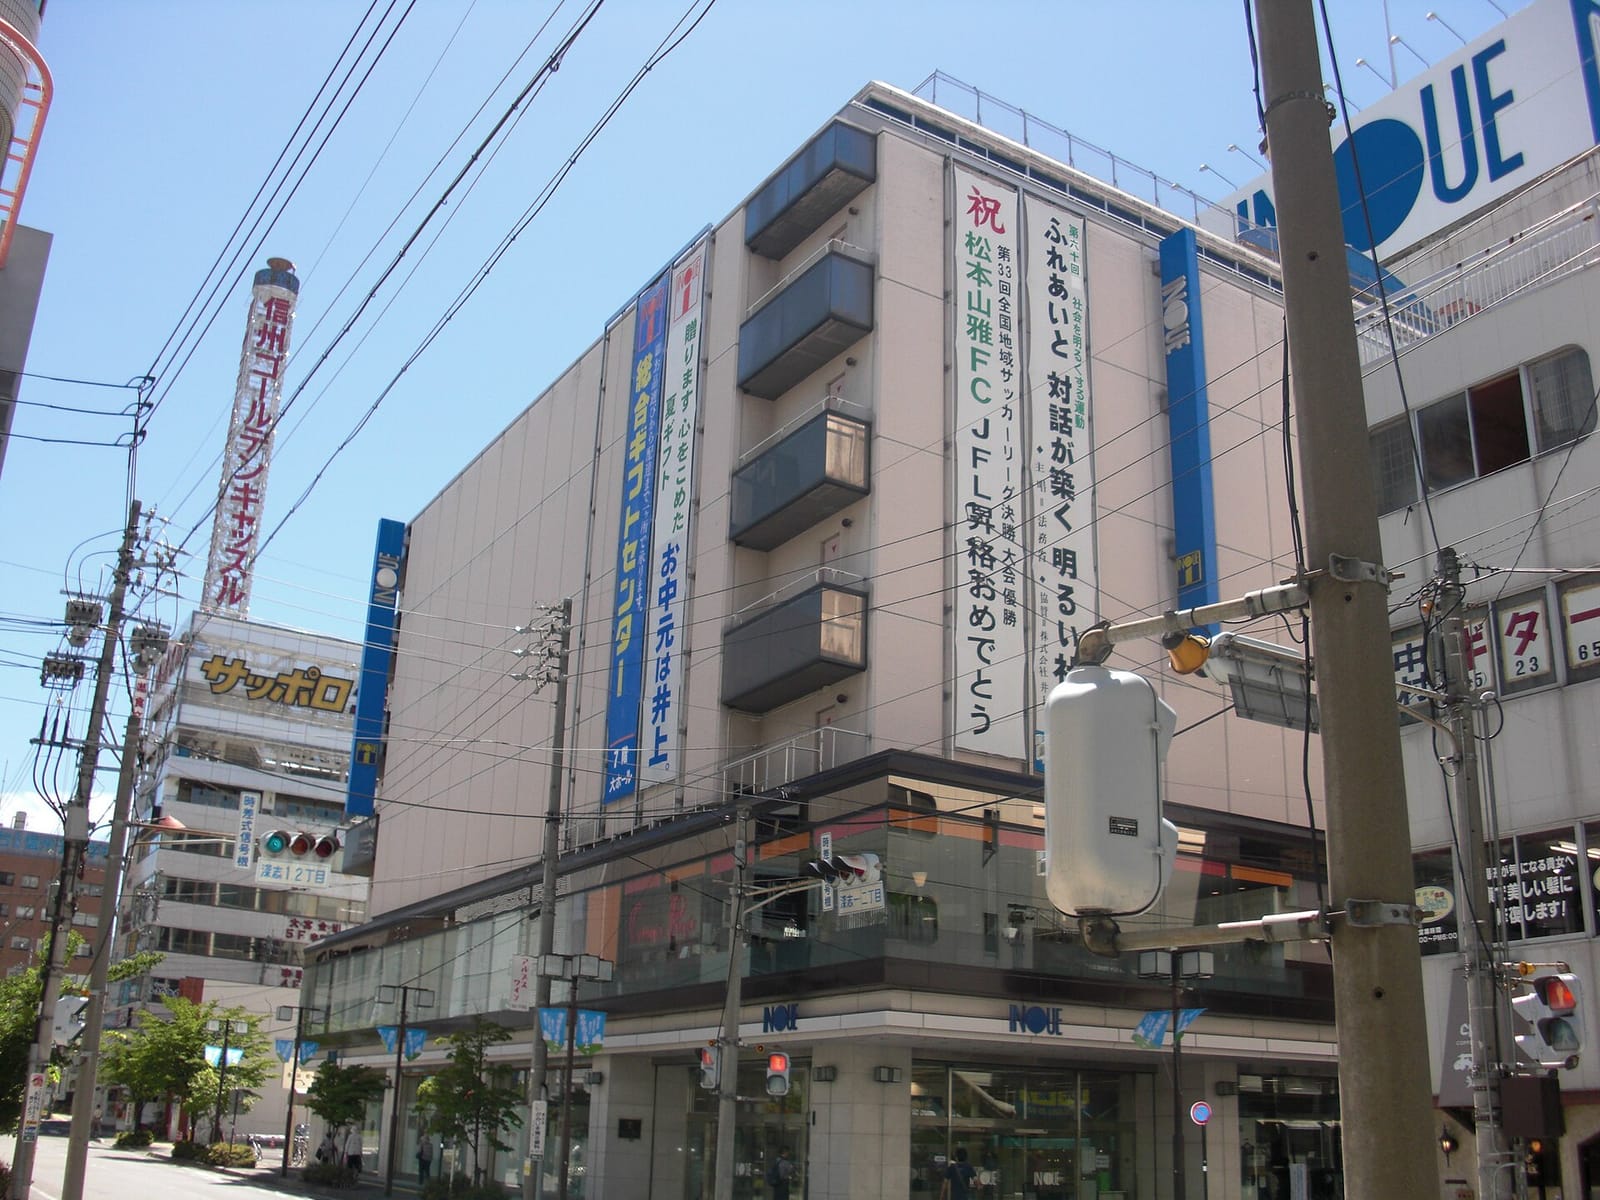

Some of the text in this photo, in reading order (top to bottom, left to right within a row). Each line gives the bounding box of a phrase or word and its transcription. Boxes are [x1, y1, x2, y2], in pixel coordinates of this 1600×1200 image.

[966, 184, 1006, 235] 祝
[1068, 223, 1081, 275] 第六十回
[1161, 274, 1191, 356] INOUE
[216, 296, 291, 606] 信州ゴールデンキャッスル
[661, 391, 677, 491] 夏ギフト
[615, 351, 654, 698] 総合ギフトセンター
[373, 551, 400, 605] INOUE
[200, 653, 354, 714] サッポロ
[1515, 656, 1540, 677] 23
[236, 795, 256, 867] 時差式信号機
[763, 1002, 800, 1034] INOUE
[1009, 1003, 1063, 1036] INOUE
